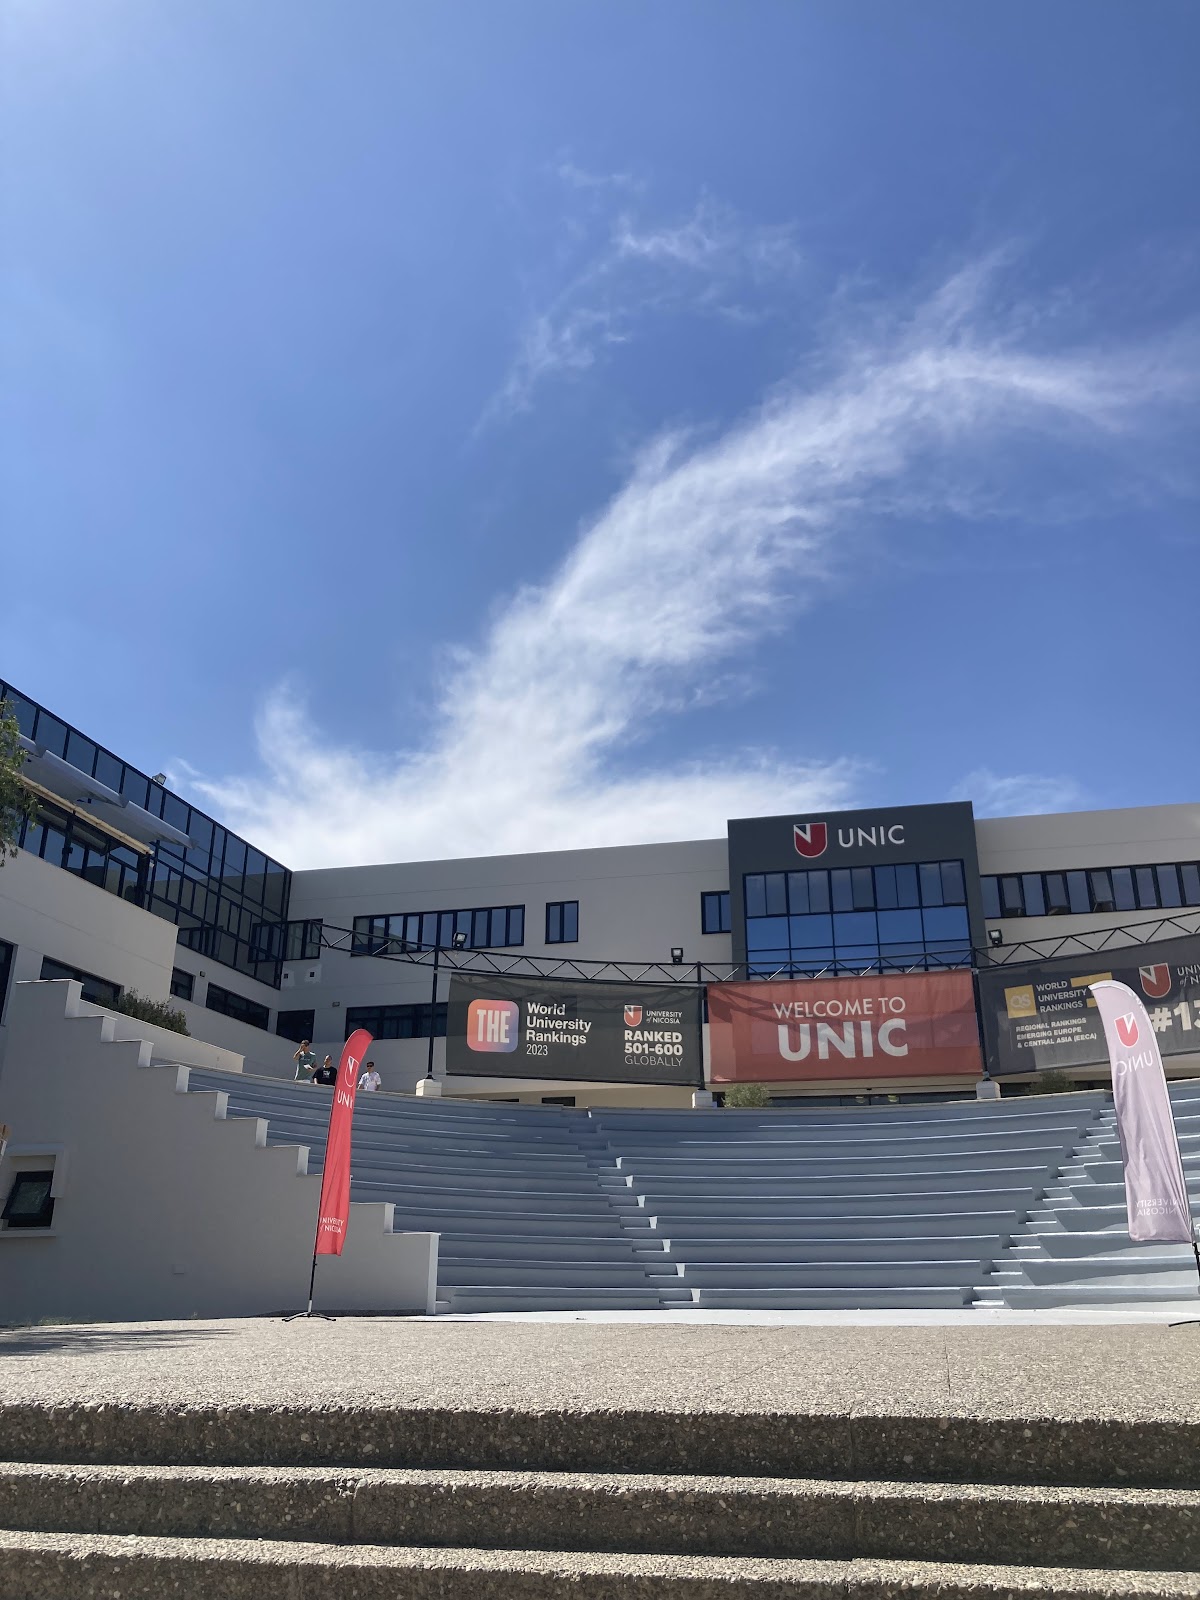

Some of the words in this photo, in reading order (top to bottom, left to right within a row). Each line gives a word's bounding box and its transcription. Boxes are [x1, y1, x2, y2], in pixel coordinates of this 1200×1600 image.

[838, 824, 905, 848] UNIC
[1036, 980, 1068, 992] WORLD
[1010, 993, 1031, 1008] QS
[1037, 988, 1087, 1003] UNIVERSITY
[527, 1002, 566, 1016] World
[646, 1010, 682, 1018] UNIVERSITY
[773, 998, 874, 1019] WELCOME
[878, 996, 906, 1014] TO
[1040, 1000, 1084, 1013] RANKINGS
[476, 1009, 511, 1044] THE
[526, 1016, 592, 1033] University
[1015, 1022, 1050, 1032] REGIONAL
[1051, 1017, 1087, 1028] RANKINGS
[526, 1029, 587, 1046] Rankings
[624, 1029, 683, 1043] RANKED
[777, 1017, 909, 1062] UNIC
[1016, 1030, 1052, 1041] EMERGING
[1053, 1026, 1082, 1036] EUROPE
[1023, 1038, 1055, 1048] CENTRAL
[1056, 1035, 1073, 1044] ASIA
[1073, 1032, 1097, 1043] (EECA)
[526, 1043, 548, 1056] 2023
[624, 1042, 683, 1056] 501-600
[624, 1054, 683, 1067] GLOBALLY
